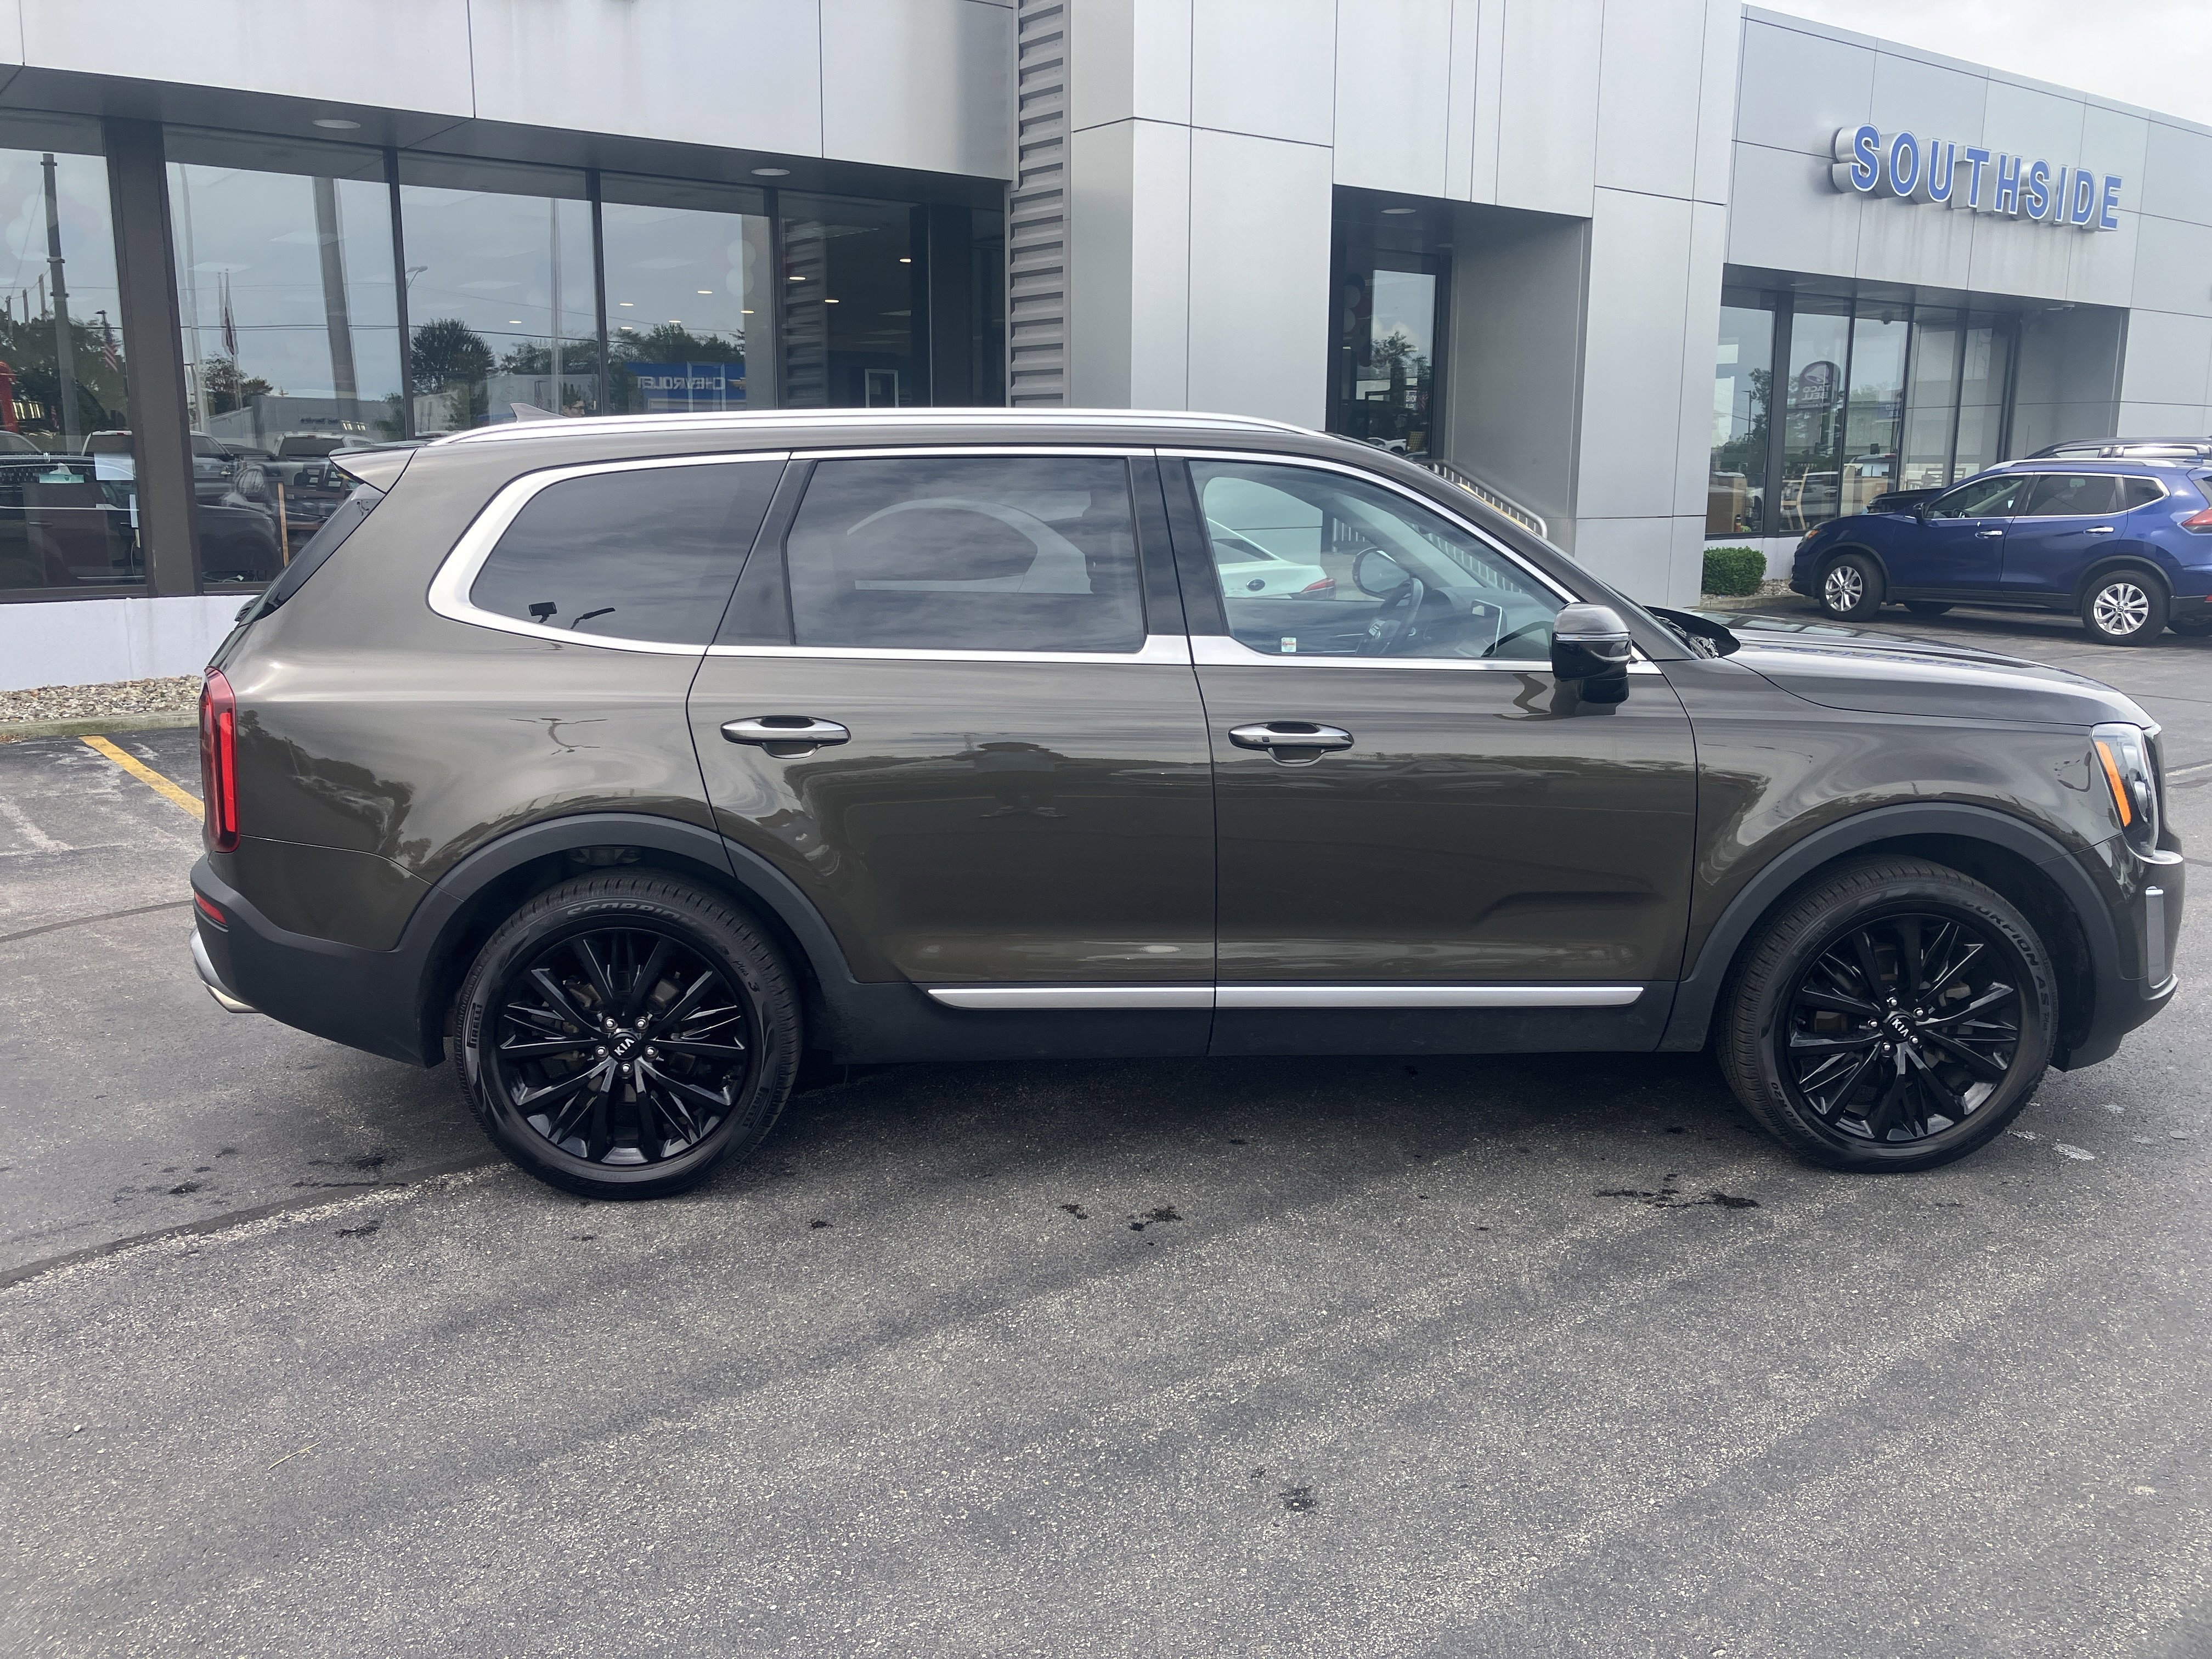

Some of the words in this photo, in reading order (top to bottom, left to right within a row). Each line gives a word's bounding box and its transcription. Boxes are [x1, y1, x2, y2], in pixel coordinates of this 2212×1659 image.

[1850, 123, 2123, 232] SOUTHSIDE
[466, 1002, 483, 1049] PIRELLI
[1892, 1018, 1909, 1037] KIA
[614, 1038, 635, 1056] KIA
